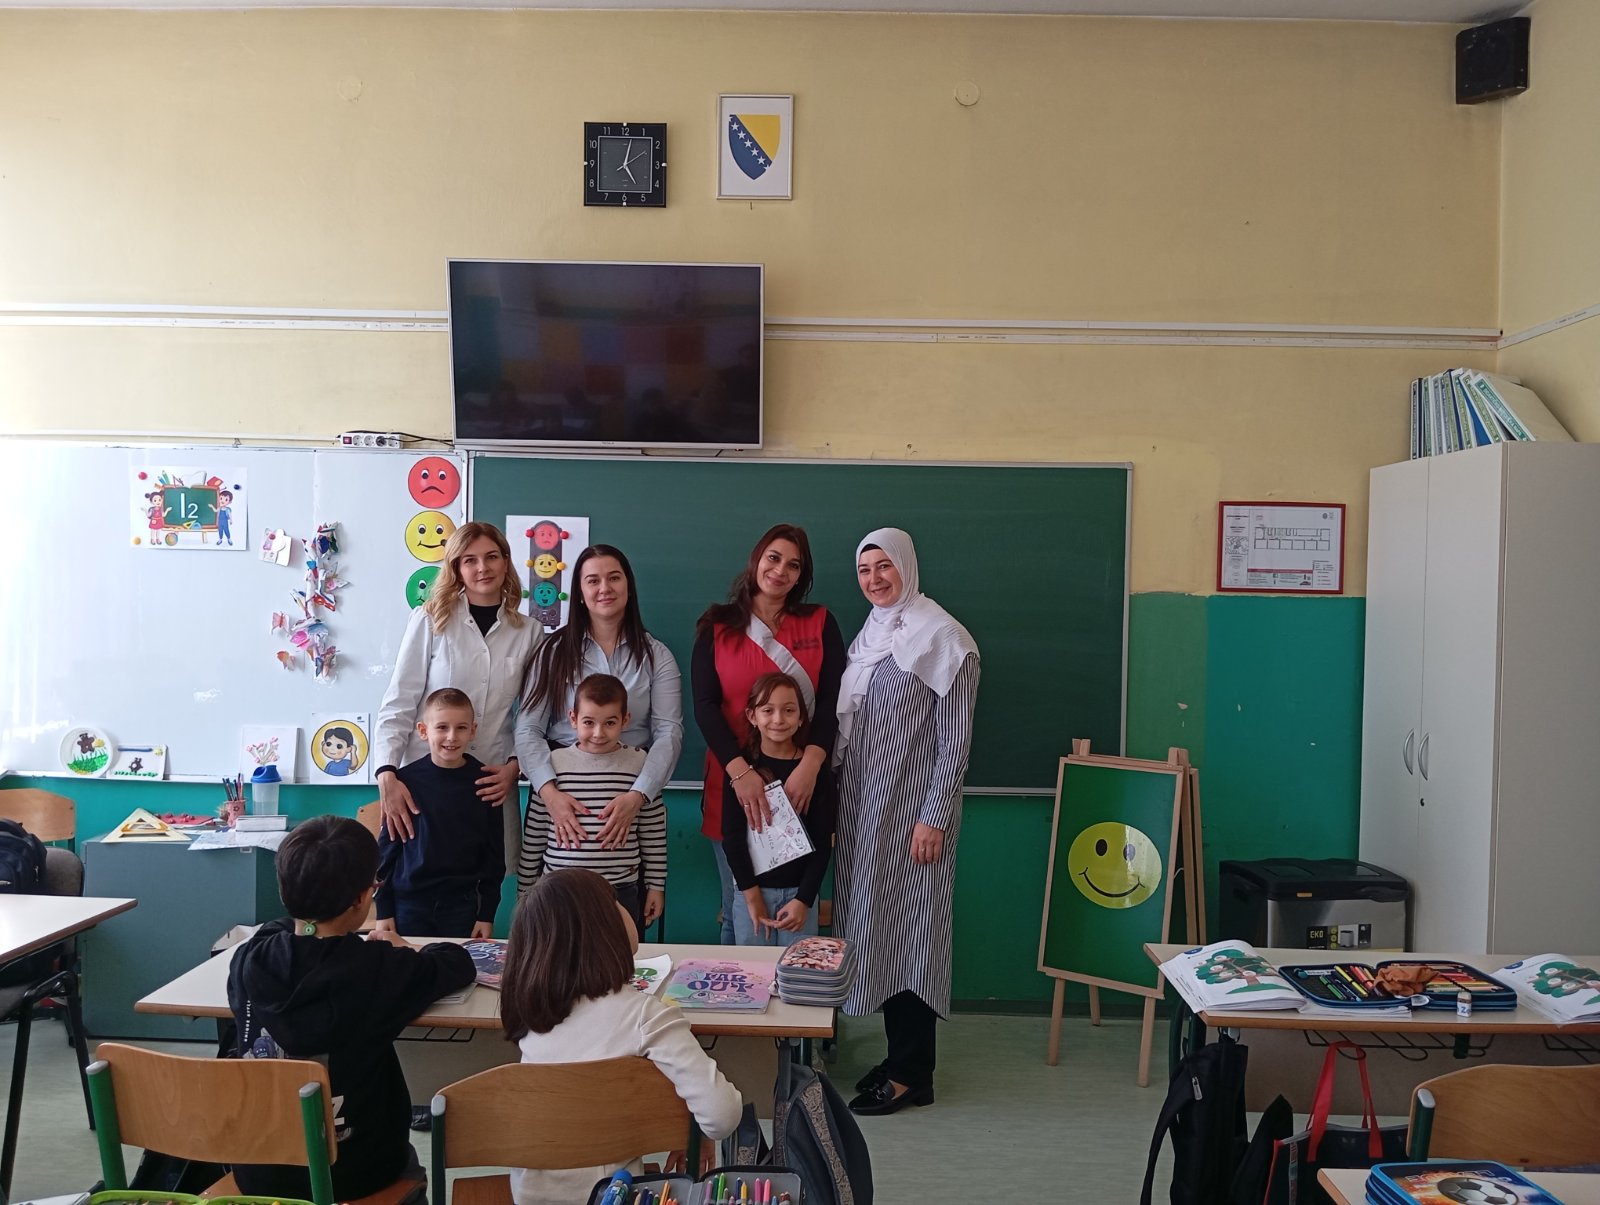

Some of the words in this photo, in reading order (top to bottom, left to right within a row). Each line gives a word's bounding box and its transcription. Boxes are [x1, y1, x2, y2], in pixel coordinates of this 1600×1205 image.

[603, 126, 611, 135] 11
[621, 128, 630, 136] 12
[642, 128, 645, 136] 1
[589, 140, 597, 149] 10
[655, 140, 660, 149] 2
[655, 161, 660, 169] 3
[589, 179, 594, 187] 8
[654, 180, 659, 188] 4
[1310, 930, 1324, 938] EKO
[687, 980, 754, 992] OUT
